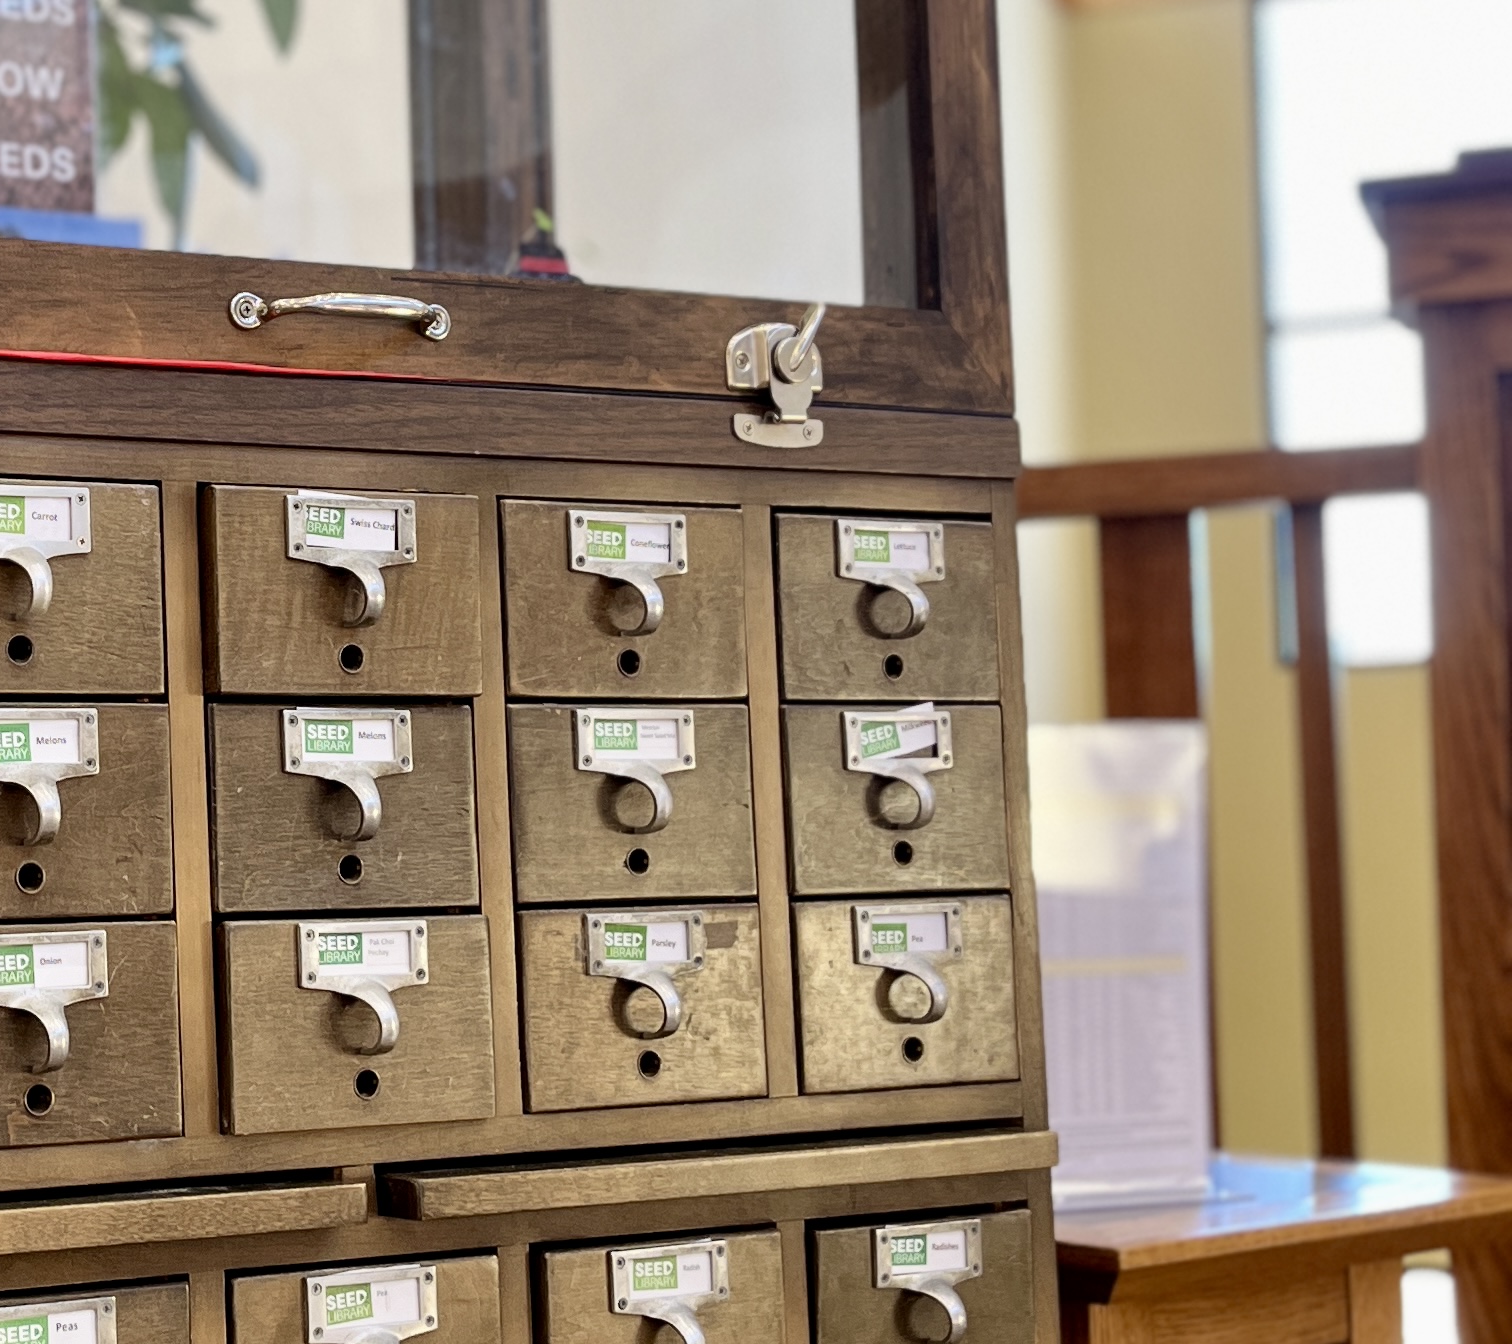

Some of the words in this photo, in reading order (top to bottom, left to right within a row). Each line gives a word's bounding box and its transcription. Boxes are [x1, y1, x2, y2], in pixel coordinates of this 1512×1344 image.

[32, 511, 57, 521] Carrot
[351, 518, 370, 528] Swiss
[373, 520, 394, 531] Chard
[854, 535, 886, 550] SEED
[308, 724, 348, 739] SEED
[359, 732, 386, 740] Melons
[596, 723, 631, 736] SEED
[861, 724, 893, 746] SEED
[36, 737, 67, 745] Melons
[309, 739, 350, 752] LIBRARY
[319, 935, 358, 951] SEED
[605, 933, 643, 947] SEED
[652, 939, 676, 948] Parsley
[872, 931, 904, 945] SEED
[40, 957, 62, 965] Onion
[891, 1239, 924, 1253] SEED
[932, 1243, 958, 1251] Radishes
[635, 1261, 673, 1276] SEED
[326, 1290, 367, 1310] SEED
[328, 1305, 371, 1322] LIBRARY
[56, 1323, 78, 1331] Peas
